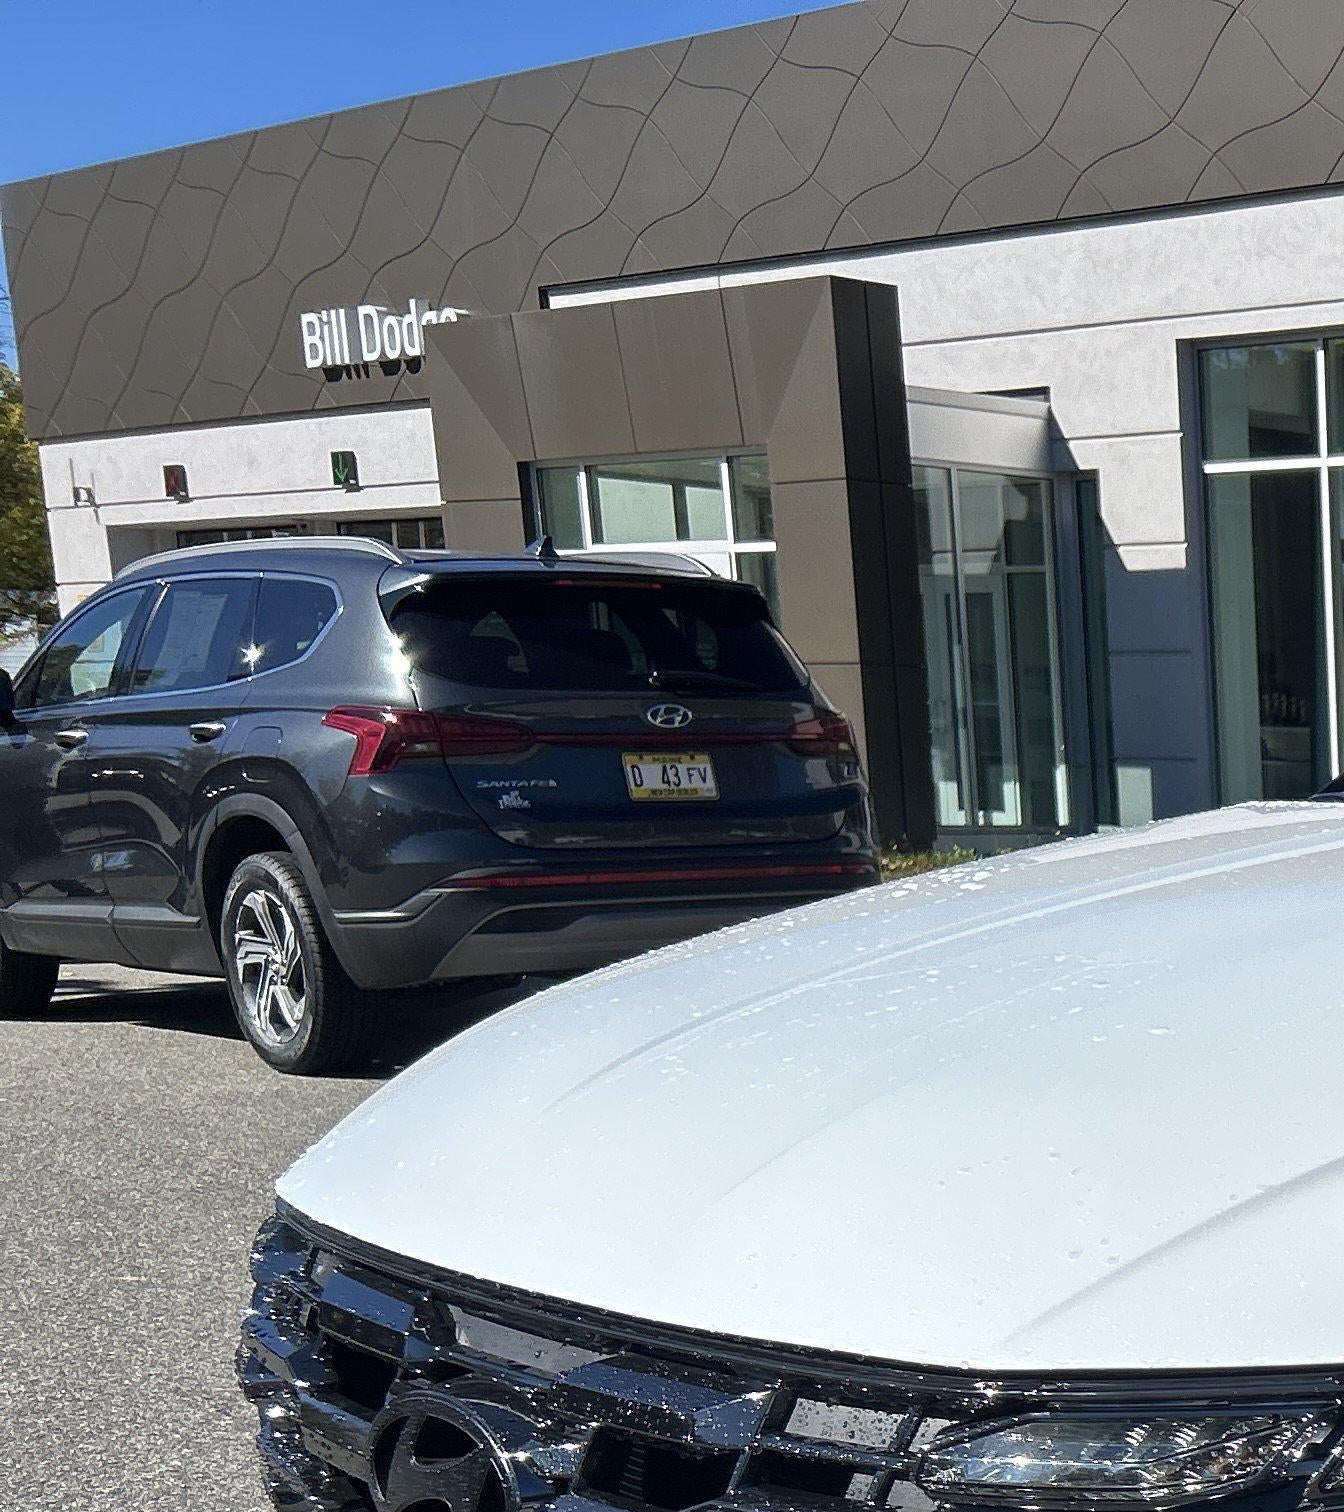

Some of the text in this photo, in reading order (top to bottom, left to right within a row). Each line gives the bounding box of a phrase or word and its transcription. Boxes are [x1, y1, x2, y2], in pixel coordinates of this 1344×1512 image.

[301, 298, 459, 369] Bill Dod
[662, 763, 681, 788] 43
[686, 766, 707, 785] FV
